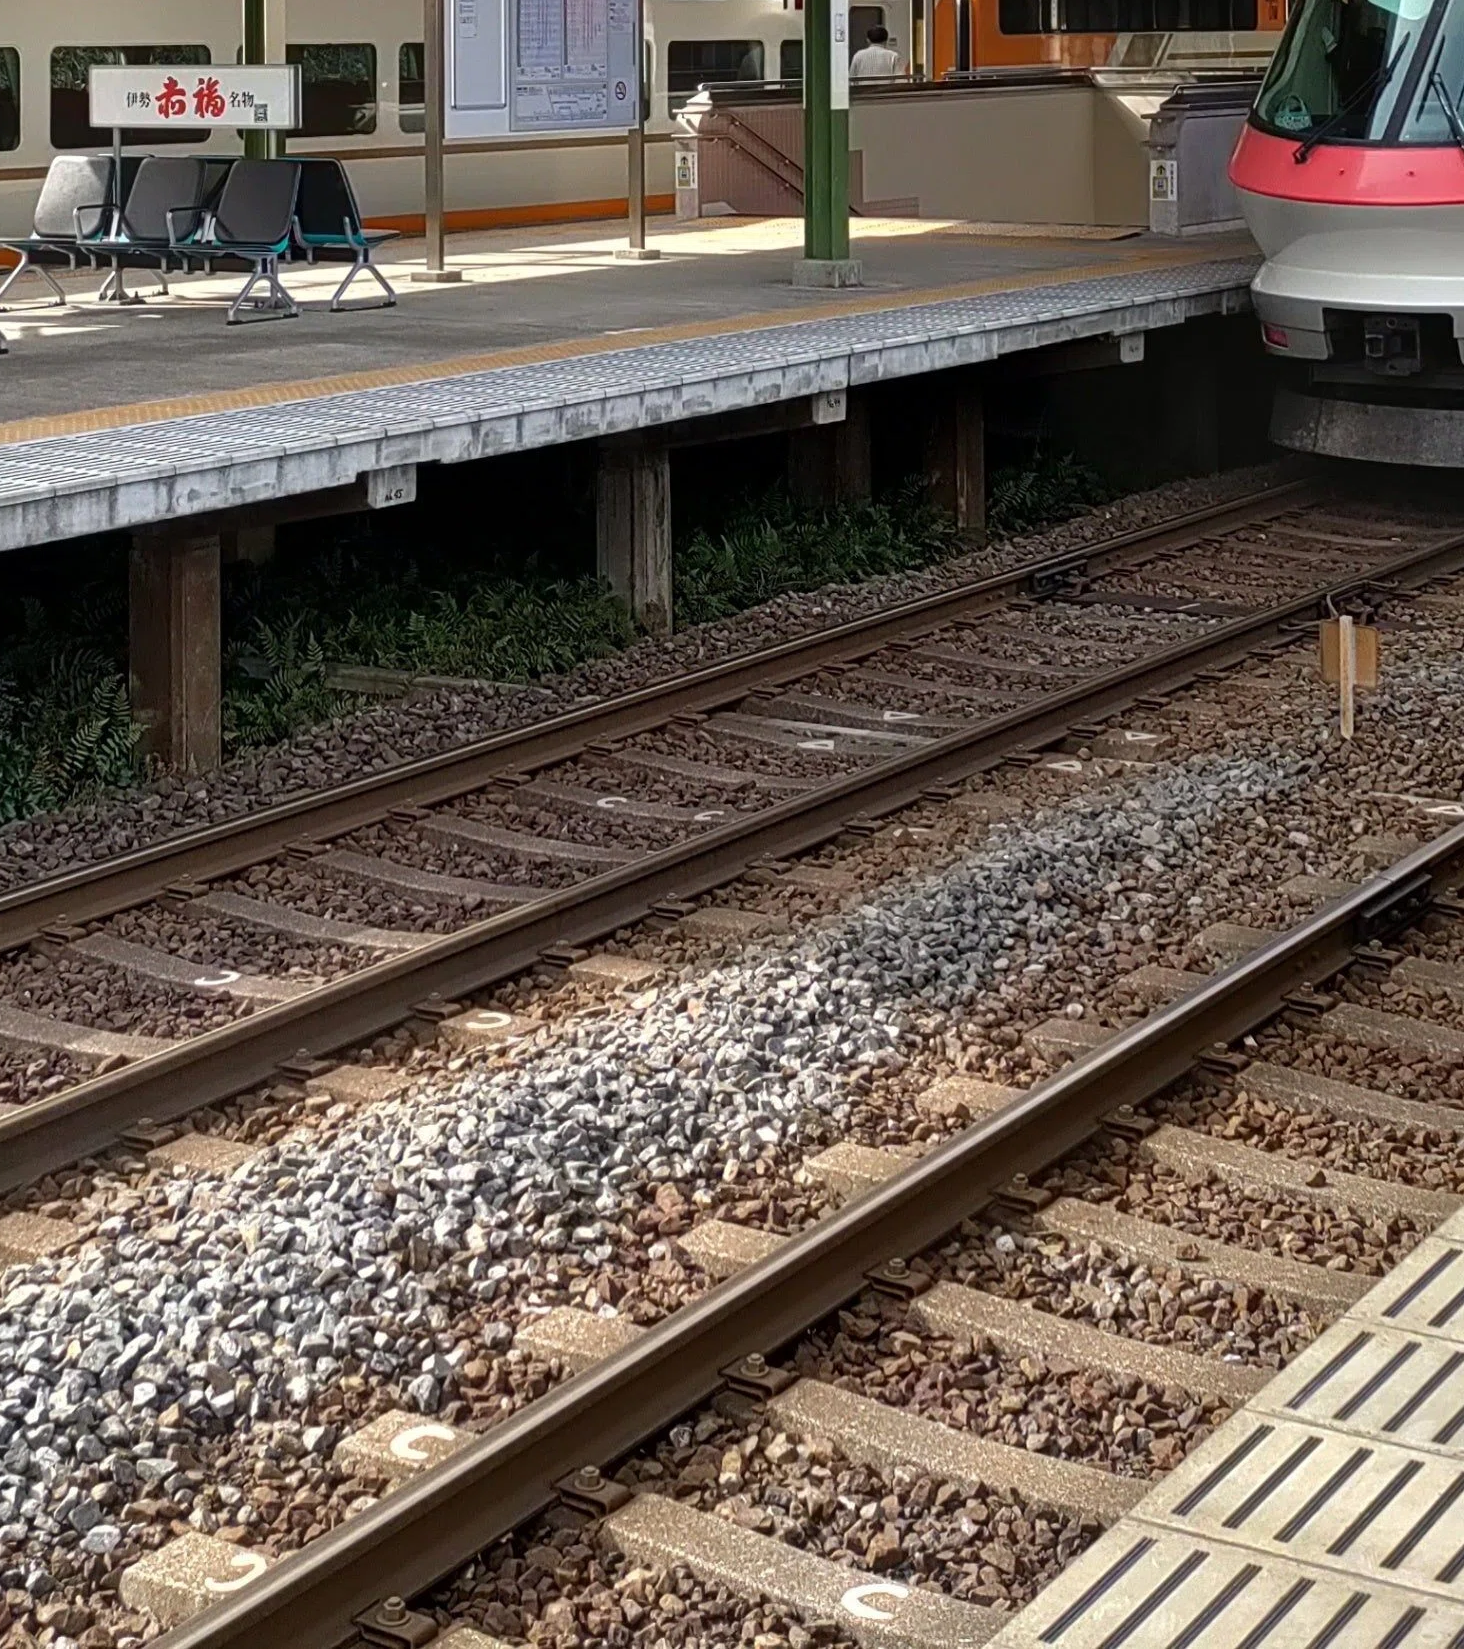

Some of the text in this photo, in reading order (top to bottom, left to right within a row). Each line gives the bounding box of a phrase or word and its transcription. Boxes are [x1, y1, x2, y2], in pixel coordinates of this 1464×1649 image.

[126, 76, 254, 119] 伊勢 赤福 名物
